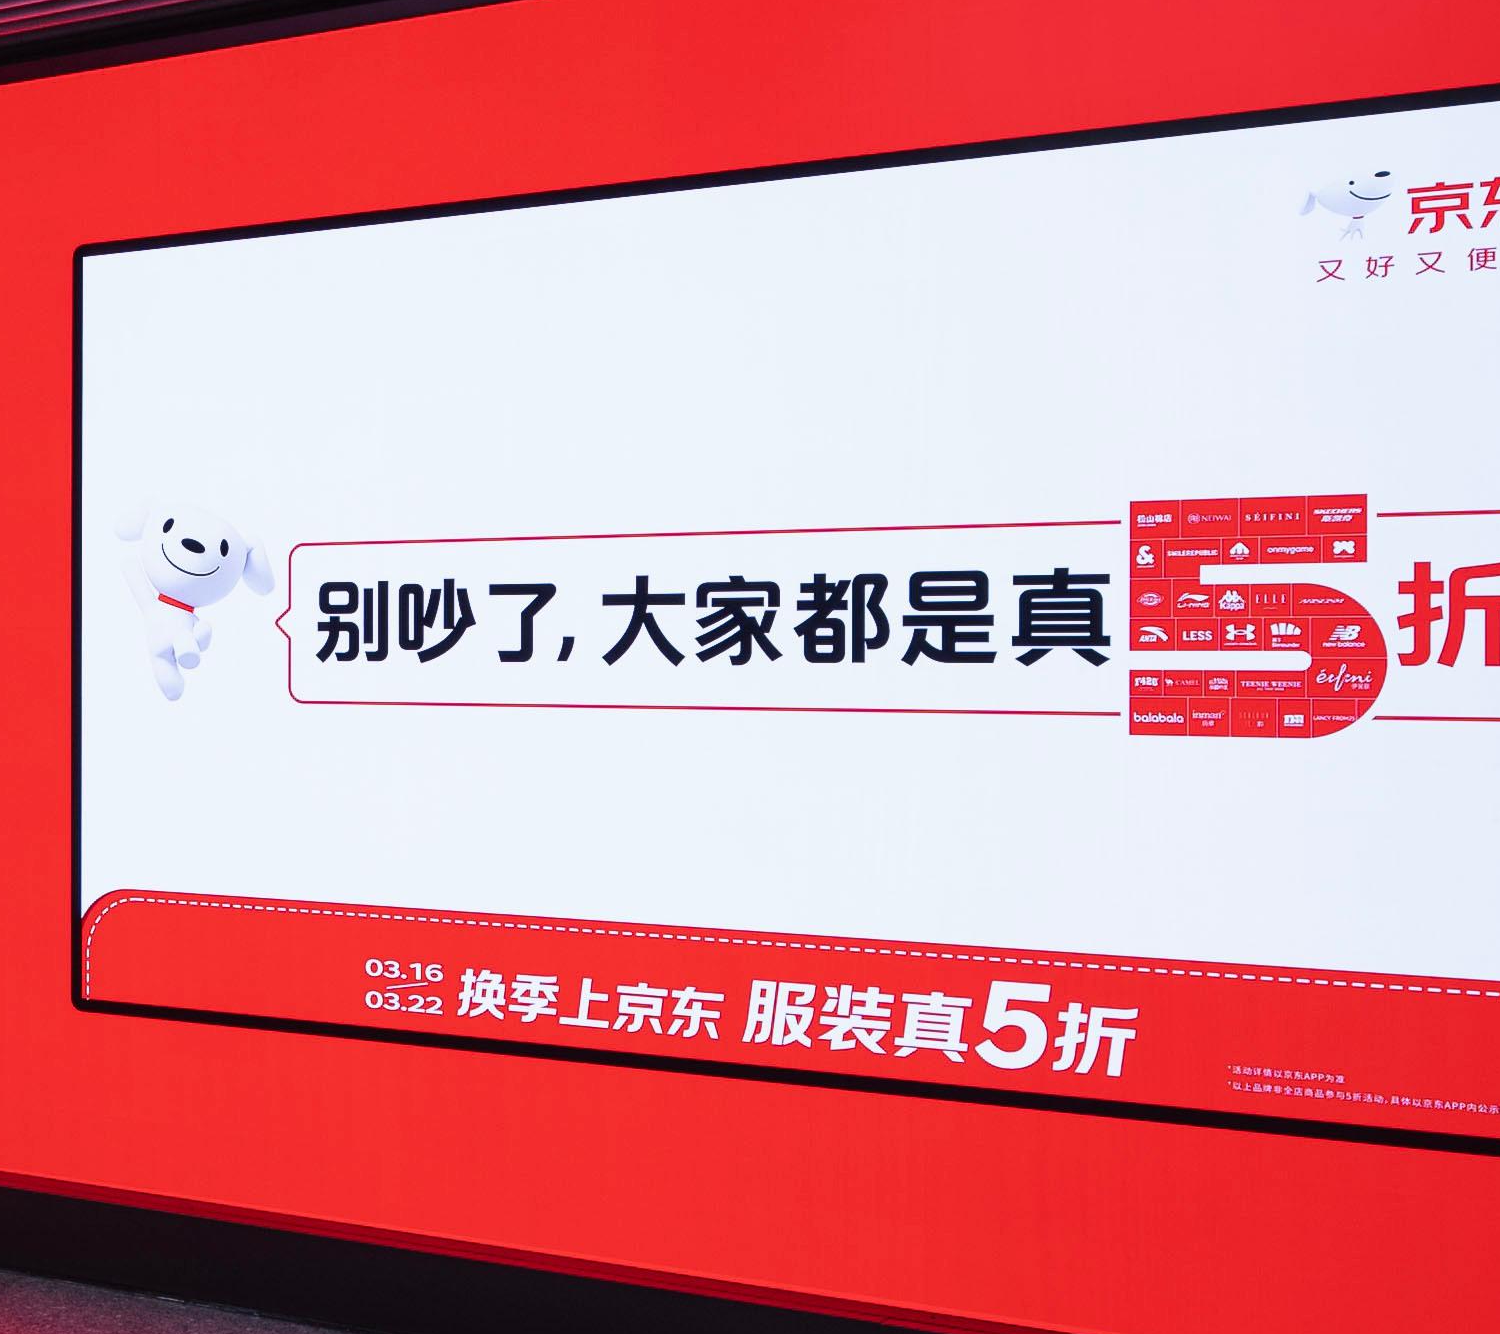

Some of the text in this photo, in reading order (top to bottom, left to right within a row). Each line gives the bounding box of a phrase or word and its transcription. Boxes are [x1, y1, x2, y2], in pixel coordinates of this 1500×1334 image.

[1244, 512, 1301, 523] SÉIFINI
[1255, 593, 1288, 604] ELLE
[1219, 600, 1246, 612] Kappa
[1182, 630, 1213, 641] LESS
[1133, 711, 1185, 724] balabala
[364, 958, 444, 984] 03.16
[364, 989, 444, 1017] 03.22
[457, 968, 1140, 1078] 换季上京东 服装真5折
